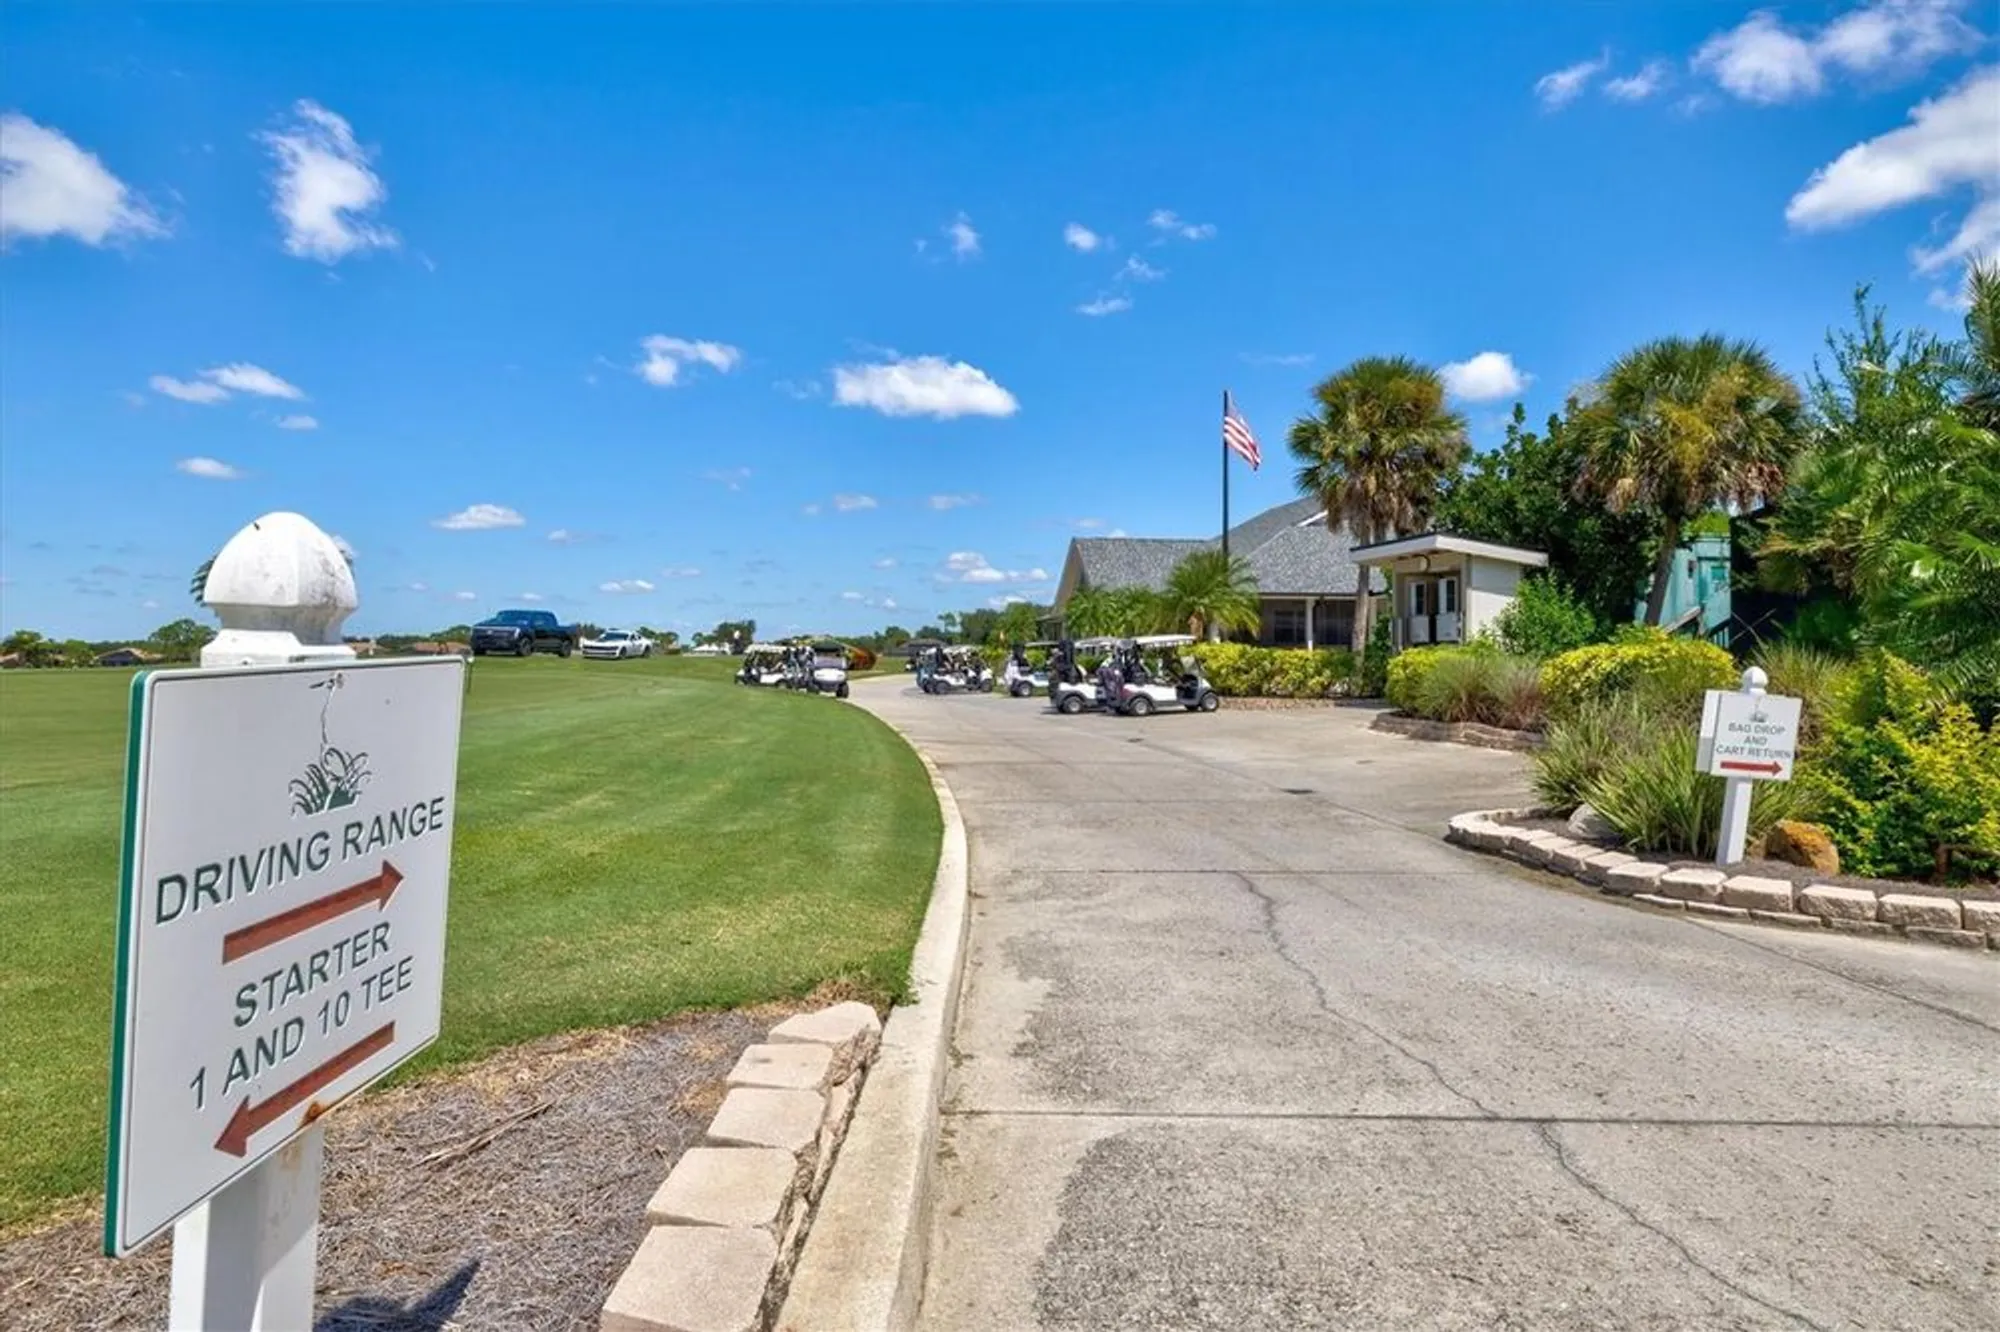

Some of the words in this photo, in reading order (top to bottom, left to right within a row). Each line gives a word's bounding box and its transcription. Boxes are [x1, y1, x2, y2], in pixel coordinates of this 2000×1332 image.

[1716, 744, 1744, 755] CART
[1747, 746, 1791, 758] RETURN
[1743, 735, 1767, 746] AND
[1754, 724, 1785, 735] DROP
[154, 829, 331, 925] DRIVING
[342, 796, 446, 862] RANGE
[233, 921, 391, 1029] STARTER
[189, 1066, 208, 1110] 1
[221, 1017, 306, 1097] AND
[317, 991, 351, 1036] 10
[360, 955, 414, 1009] TEE
